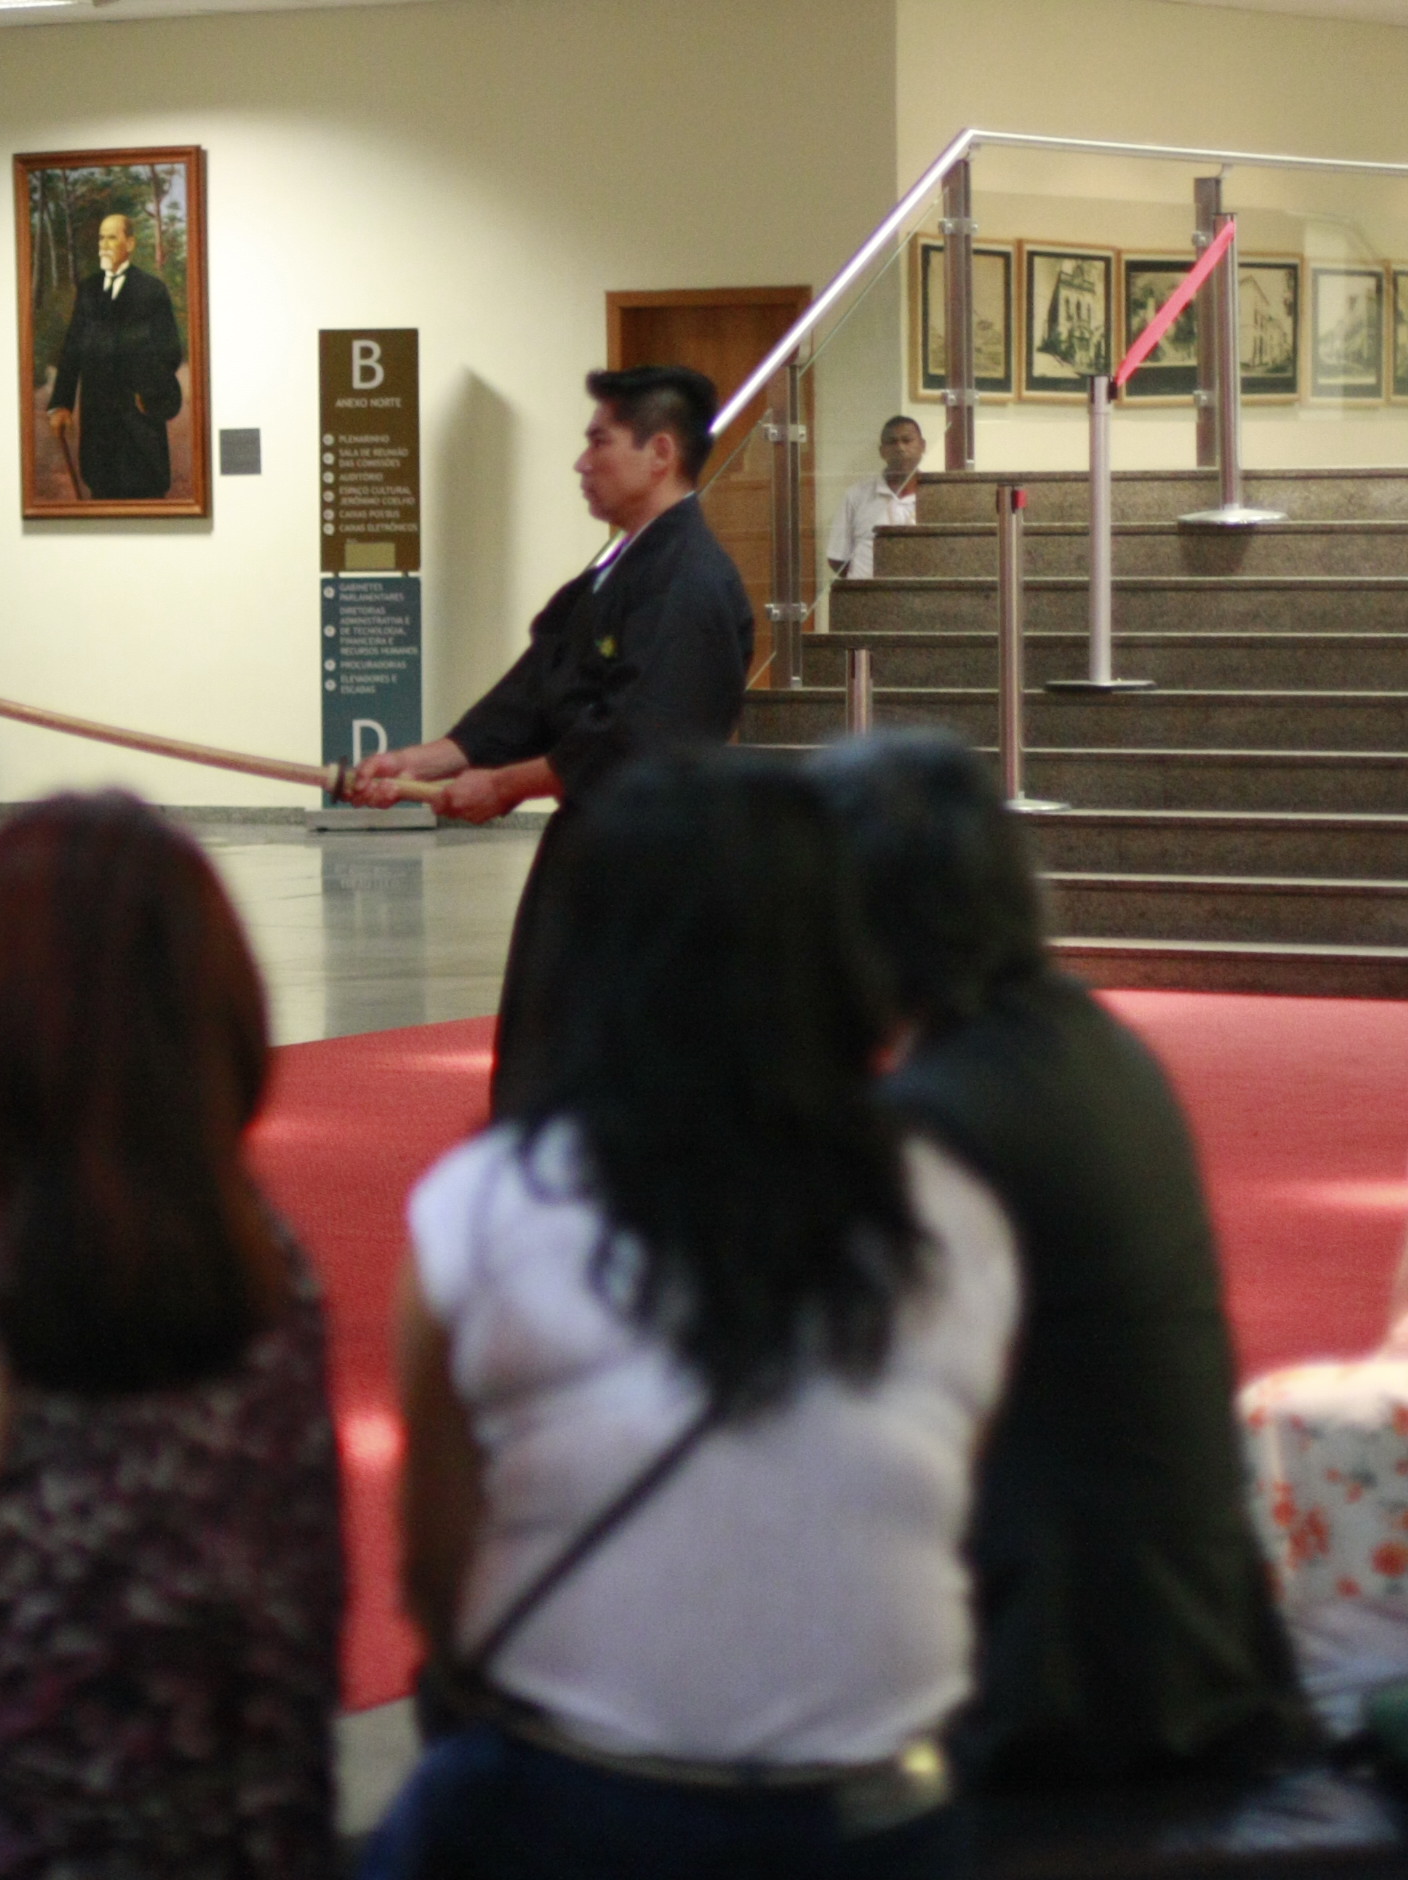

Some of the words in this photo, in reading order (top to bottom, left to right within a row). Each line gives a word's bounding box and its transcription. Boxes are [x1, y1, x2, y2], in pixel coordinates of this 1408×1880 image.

[352, 339, 385, 389] B
[335, 398, 368, 408] ANEXO
[370, 397, 401, 407] NORTE
[338, 435, 390, 444] PLENARINHO
[339, 448, 358, 457] SALA
[360, 448, 371, 457] DE
[372, 486, 411, 495] CULTURAL
[382, 497, 416, 506] COELHO
[339, 583, 383, 592] GABINETES
[352, 719, 388, 768] D
